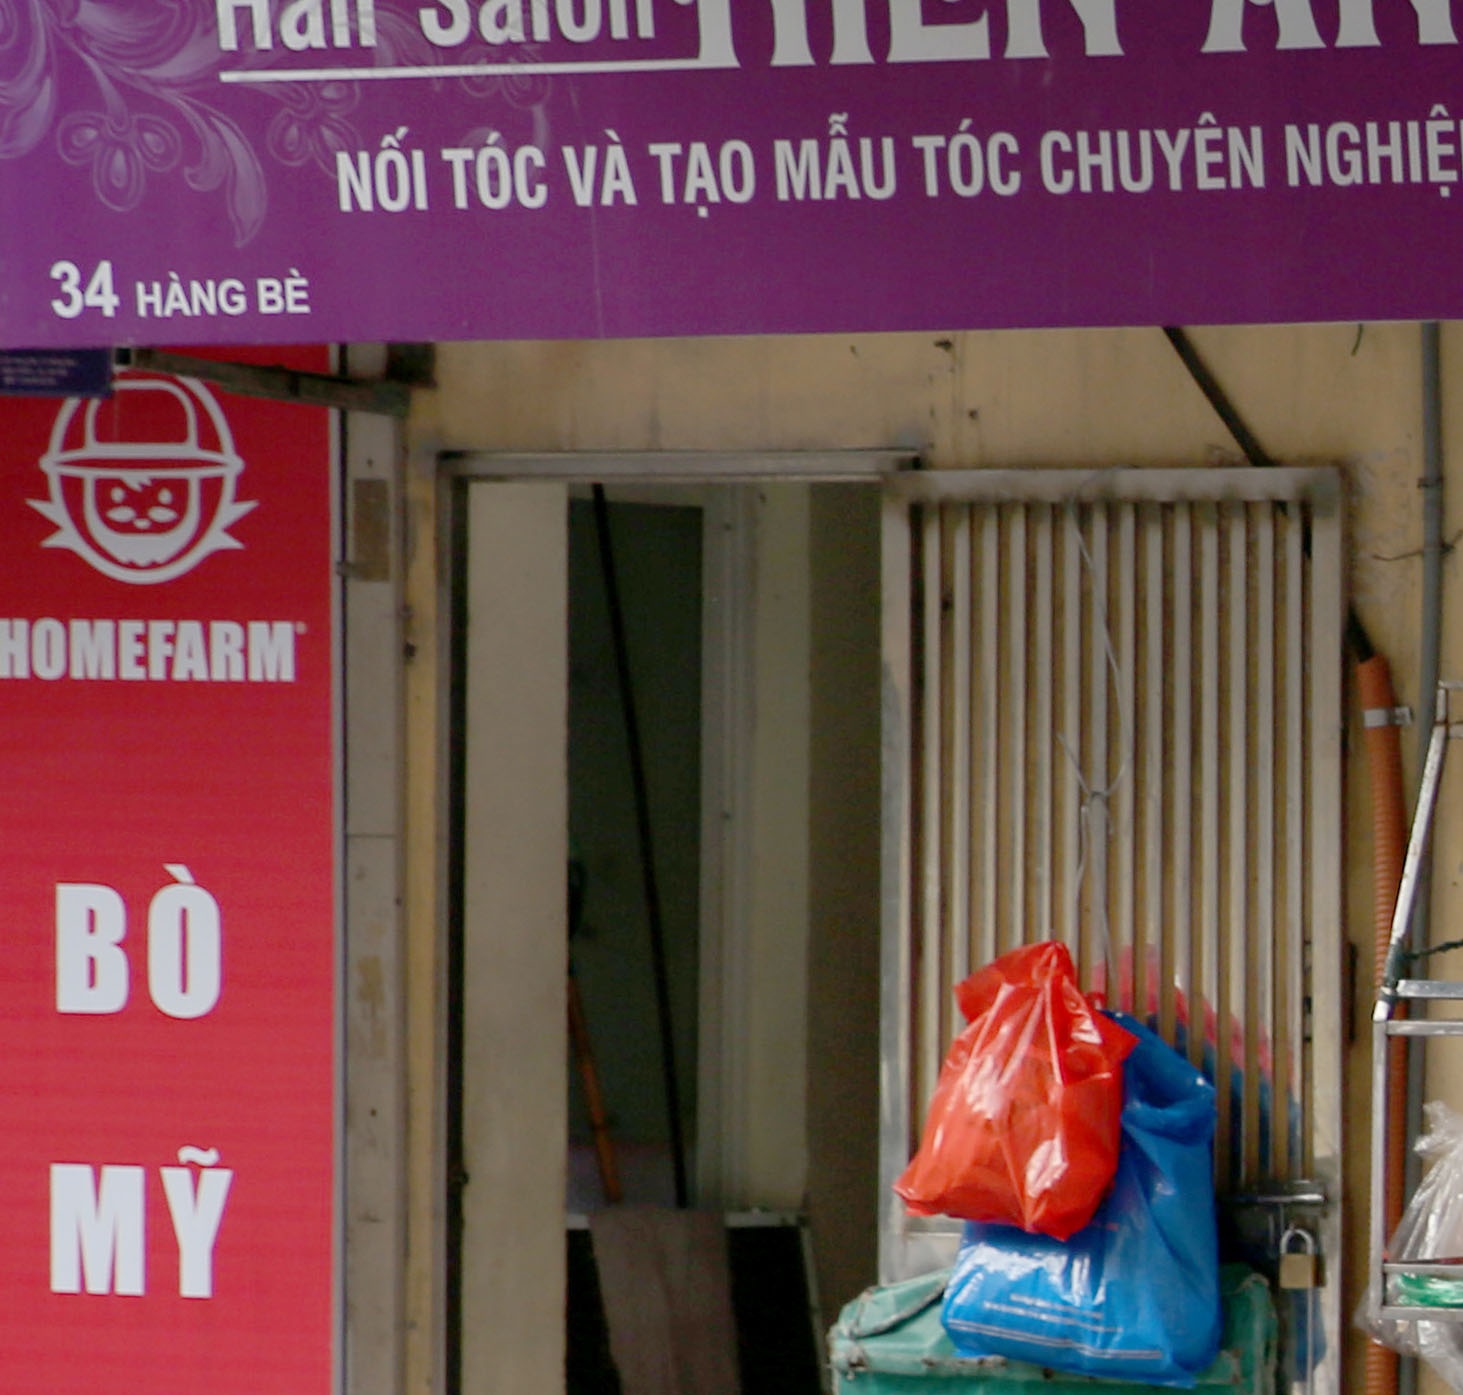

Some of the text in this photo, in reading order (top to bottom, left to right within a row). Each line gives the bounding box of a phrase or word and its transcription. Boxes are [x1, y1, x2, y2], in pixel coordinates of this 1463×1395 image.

[337, 127, 427, 212] NỐI
[443, 133, 547, 209] TÓC
[564, 129, 637, 205] VÀ
[651, 142, 756, 218] TẠO
[776, 113, 897, 201] MẪU
[914, 119, 1022, 199] TÓC
[1041, 112, 1266, 194] CHUYÊN
[50, 260, 311, 319] 34 HÀNG BÈ
[0, 618, 296, 683] HOMEFARM
[56, 863, 222, 1019] BÒ
[50, 1146, 233, 1299] MỸ
